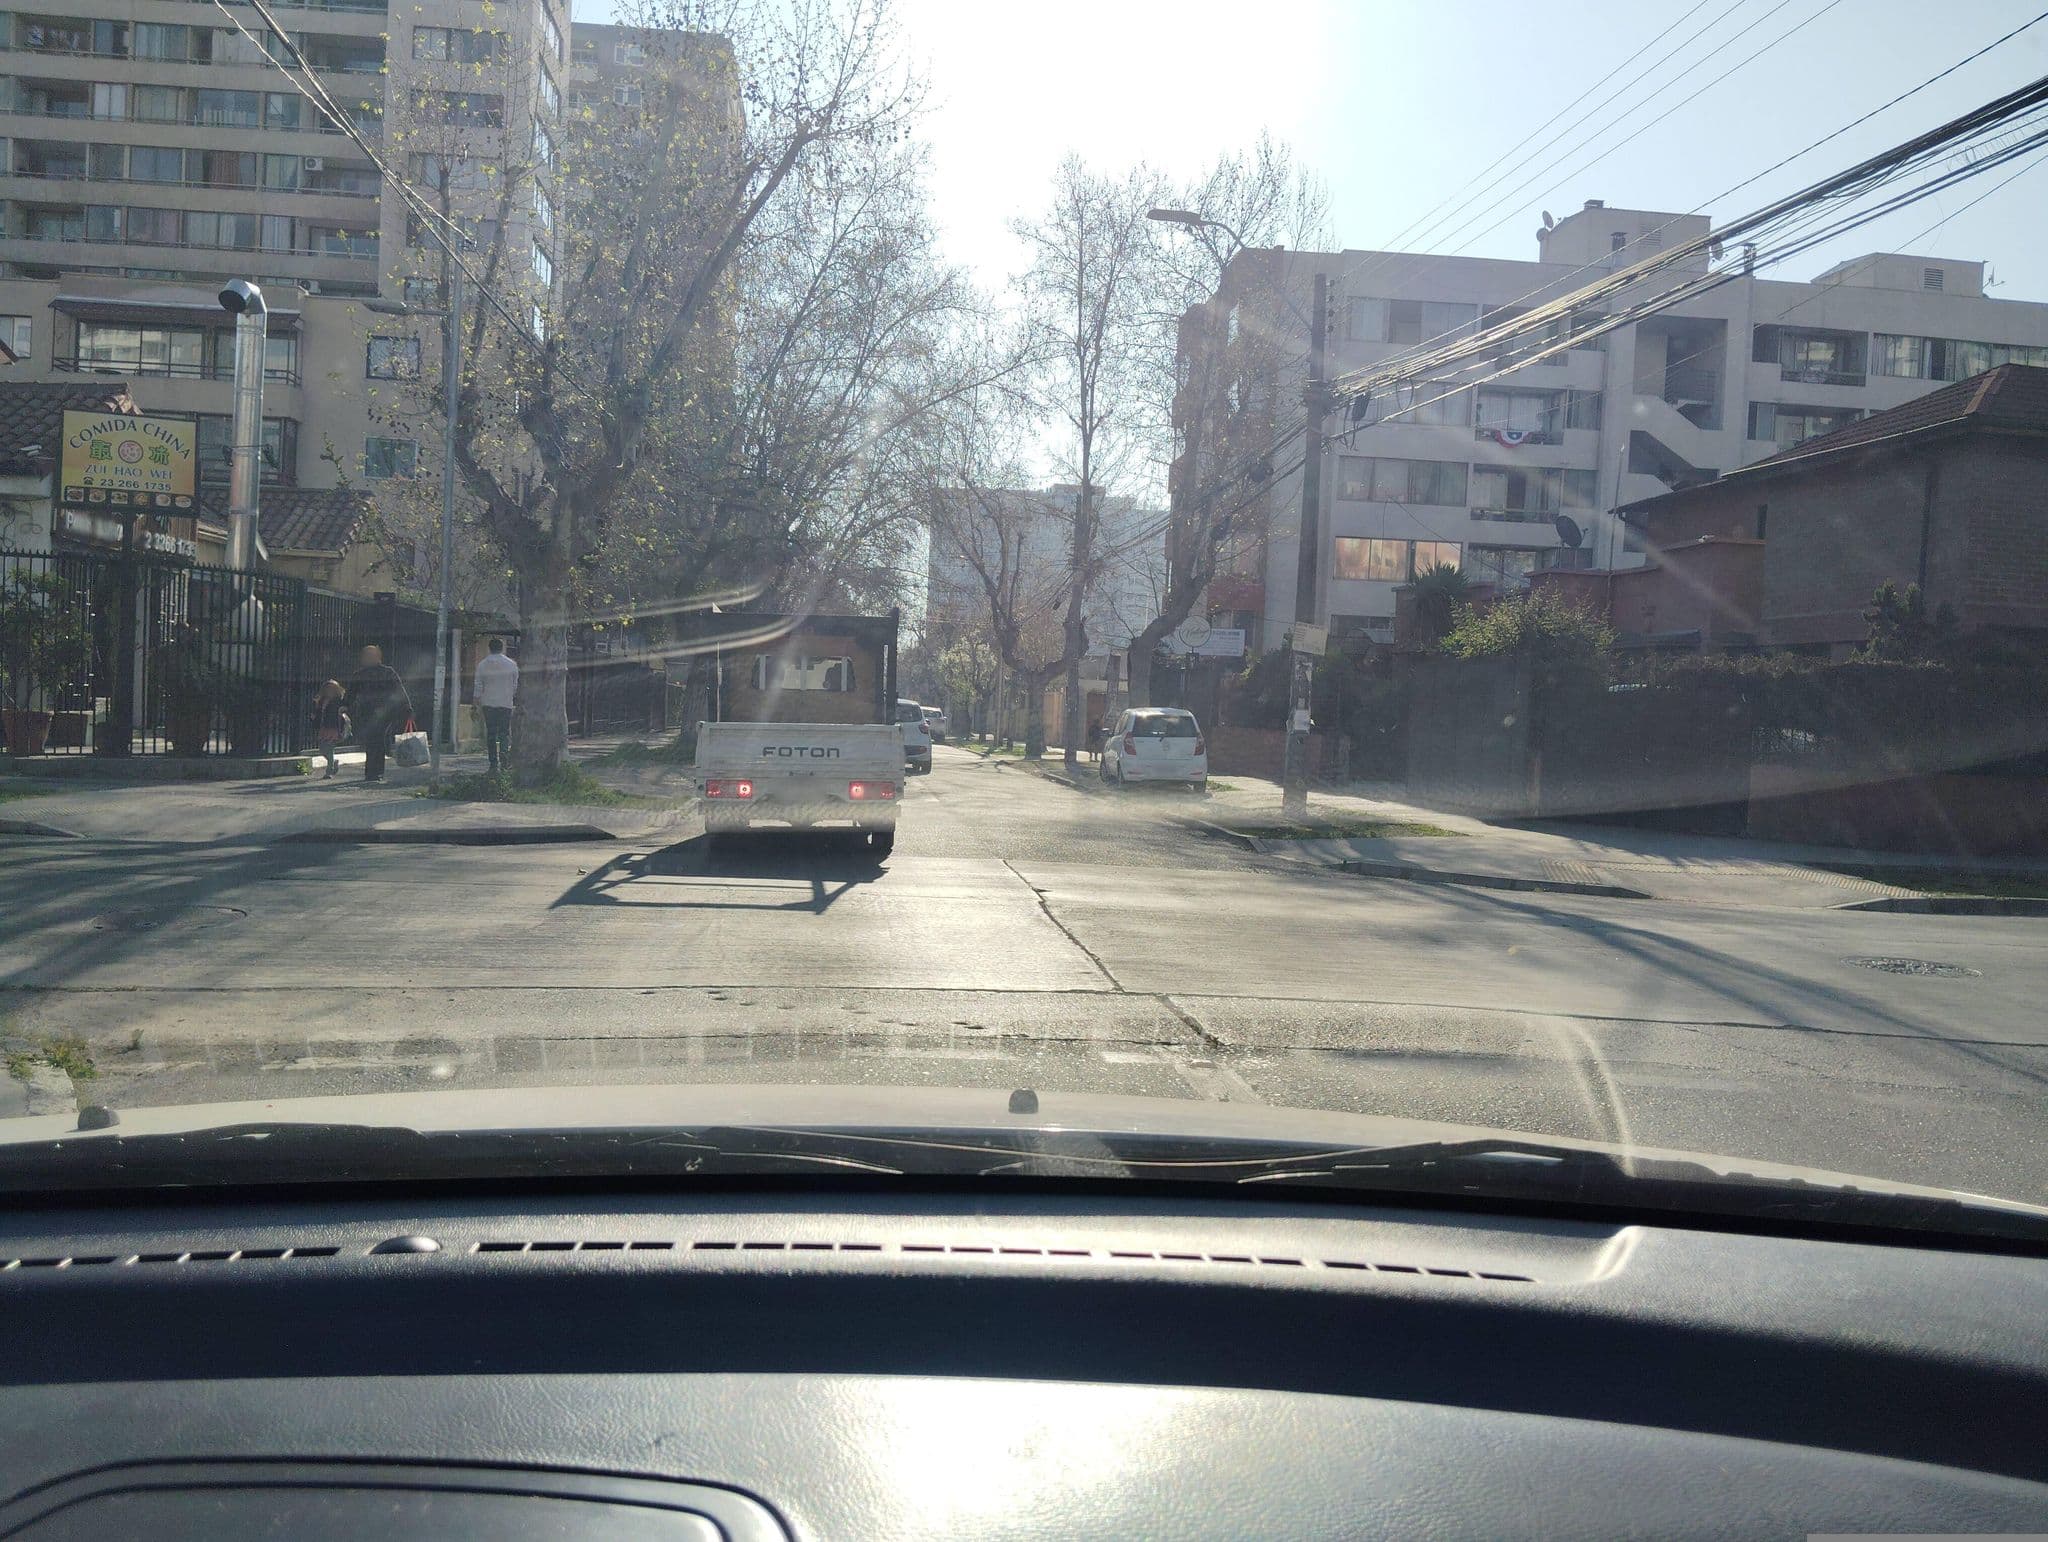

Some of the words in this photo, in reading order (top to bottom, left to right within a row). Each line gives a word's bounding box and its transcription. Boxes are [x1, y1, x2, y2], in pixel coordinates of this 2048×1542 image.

[69, 419, 137, 449] COMIDA
[143, 423, 192, 460] CHINA
[85, 464, 106, 474] ZUI
[114, 466, 142, 477] HAO
[149, 469, 172, 480] WEI
[100, 479, 114, 487] 23
[118, 480, 139, 489] 266
[144, 482, 172, 492] 1735
[762, 746, 840, 758] FOTON
